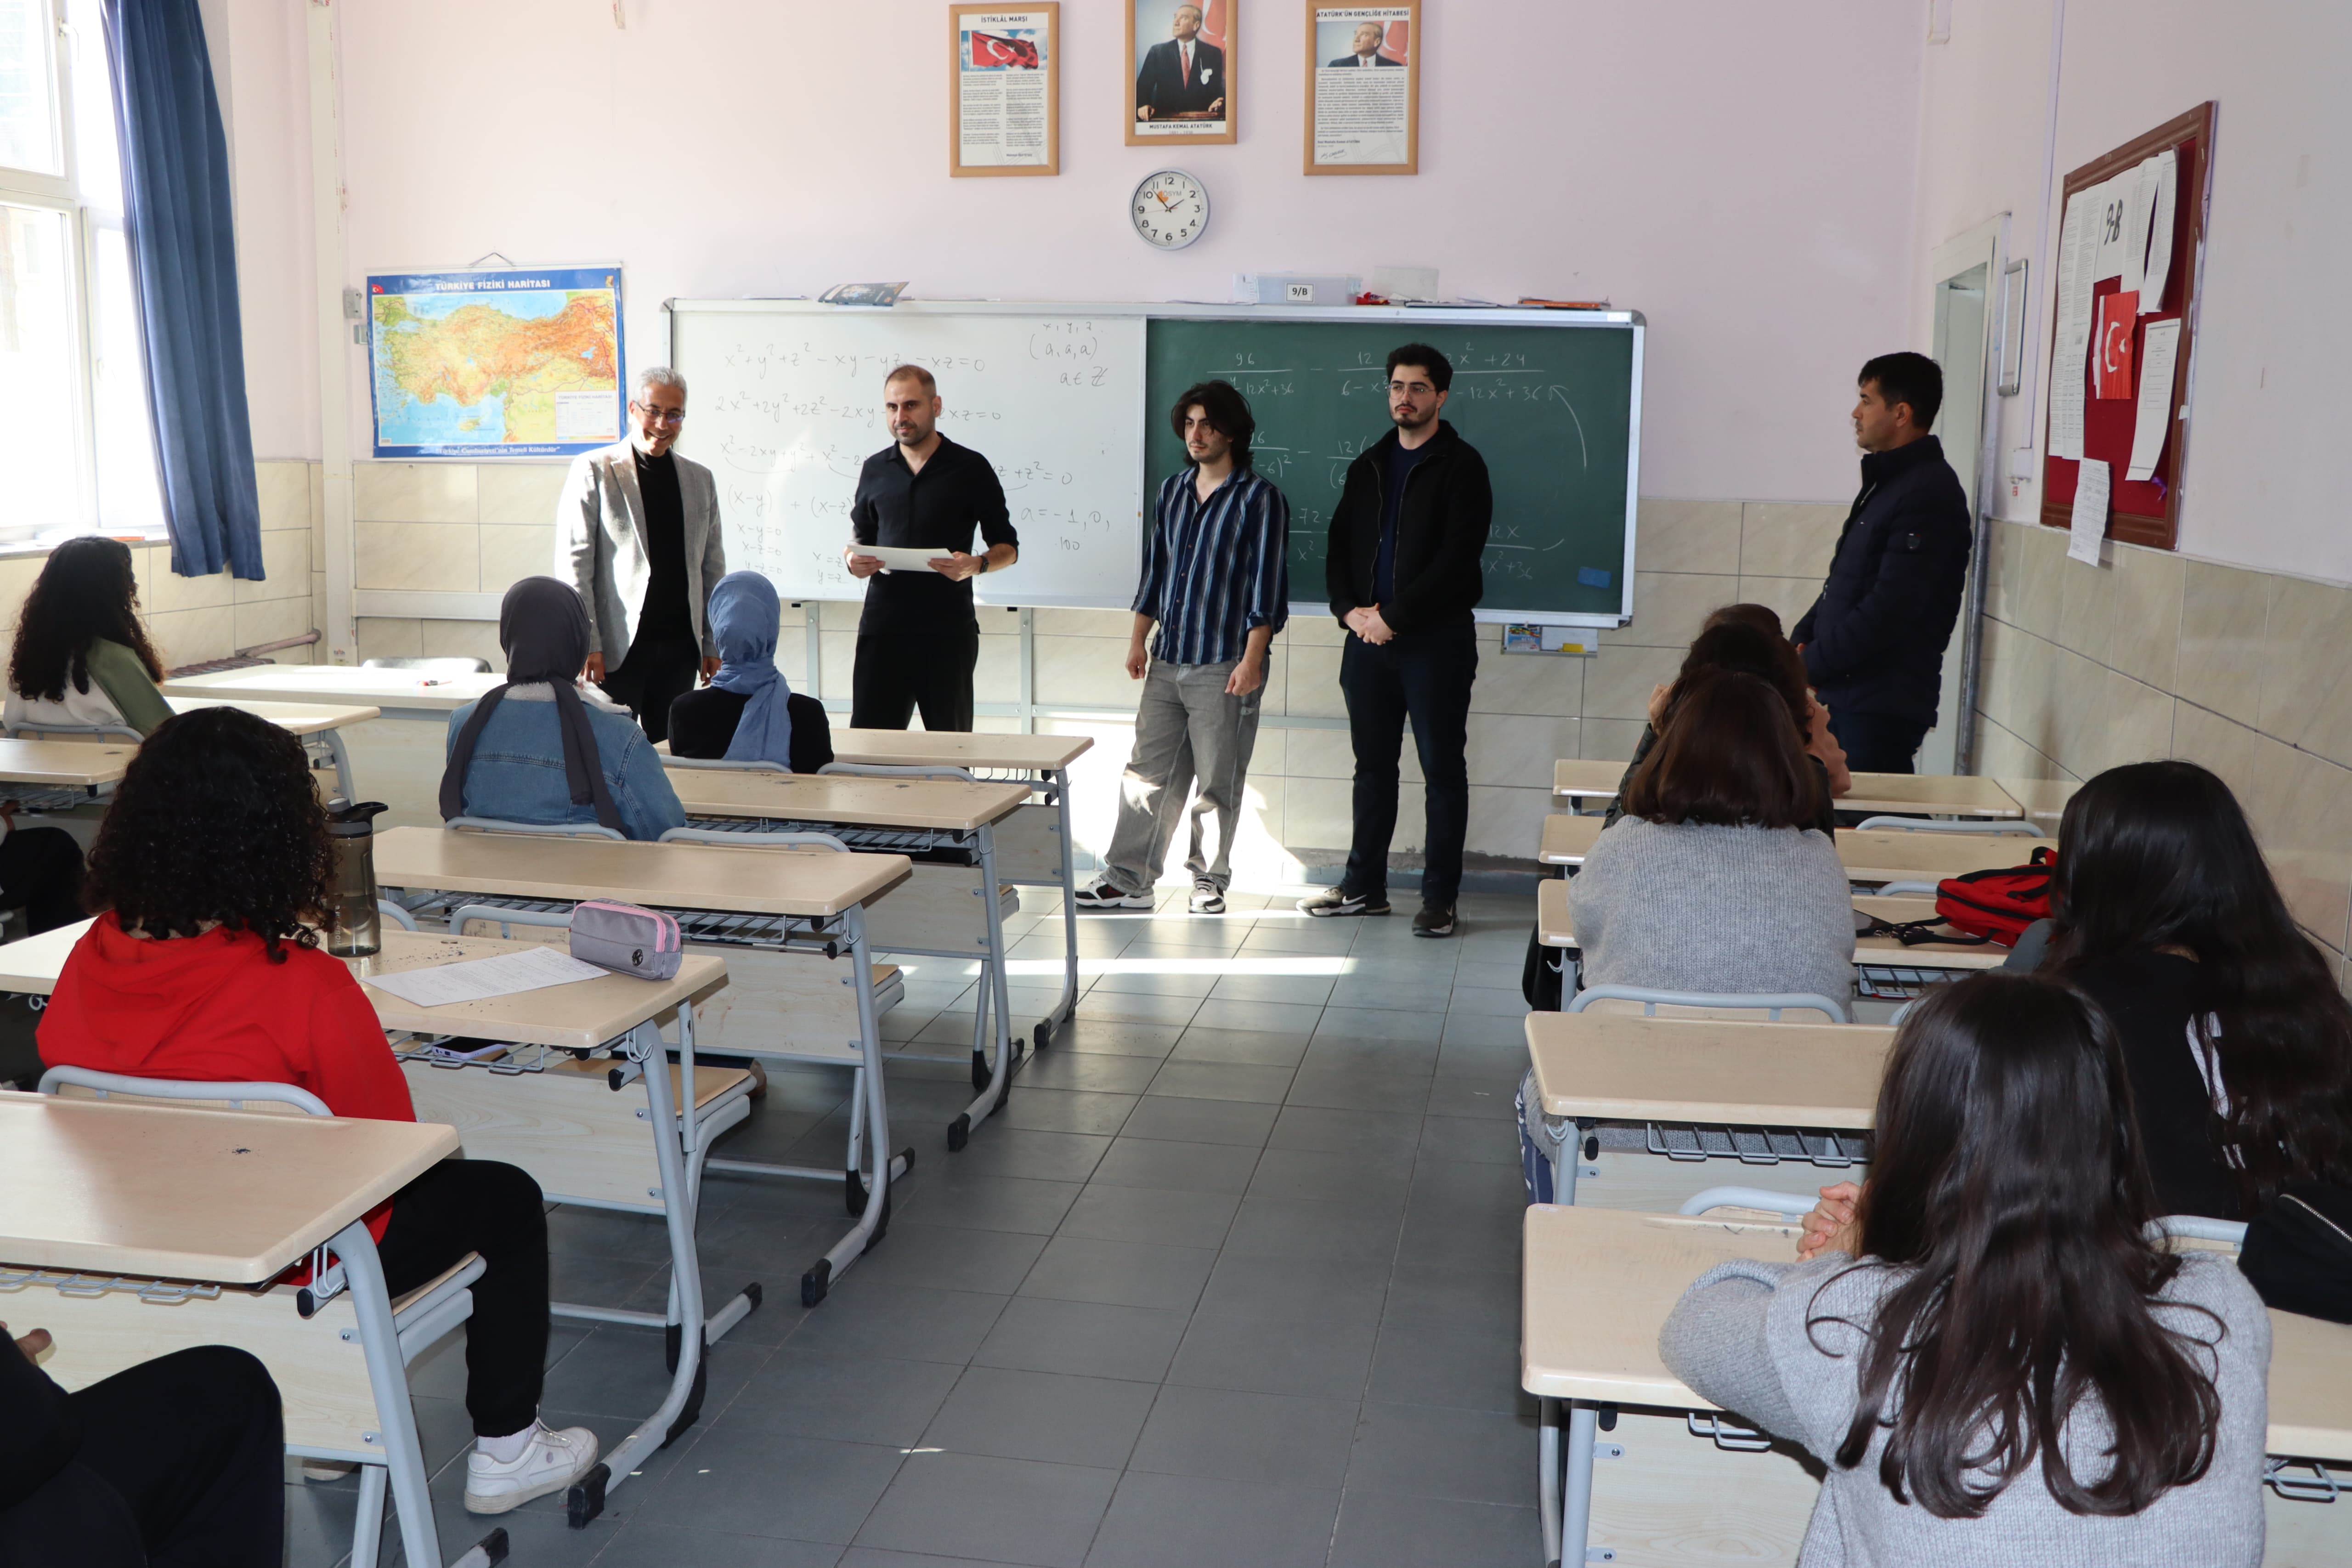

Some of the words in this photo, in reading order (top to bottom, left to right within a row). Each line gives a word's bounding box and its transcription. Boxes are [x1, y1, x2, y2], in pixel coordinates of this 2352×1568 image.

[1355, 9, 1381, 17] GENÇLİĞE
[1165, 177, 1175, 185] 12
[1182, 181, 1185, 189] 1
[1143, 191, 1153, 199] 10
[1142, 220, 1149, 228] 8
[1151, 229, 1158, 238] 7
[1165, 233, 1172, 241] 6
[1181, 229, 1187, 237] 5
[435, 281, 475, 291] TÜRKİYE
[477, 279, 505, 289] FİZİKİ
[507, 278, 551, 289] HARİTASI
[1292, 286, 1308, 297] 9/B
[1357, 351, 1373, 365] 12
